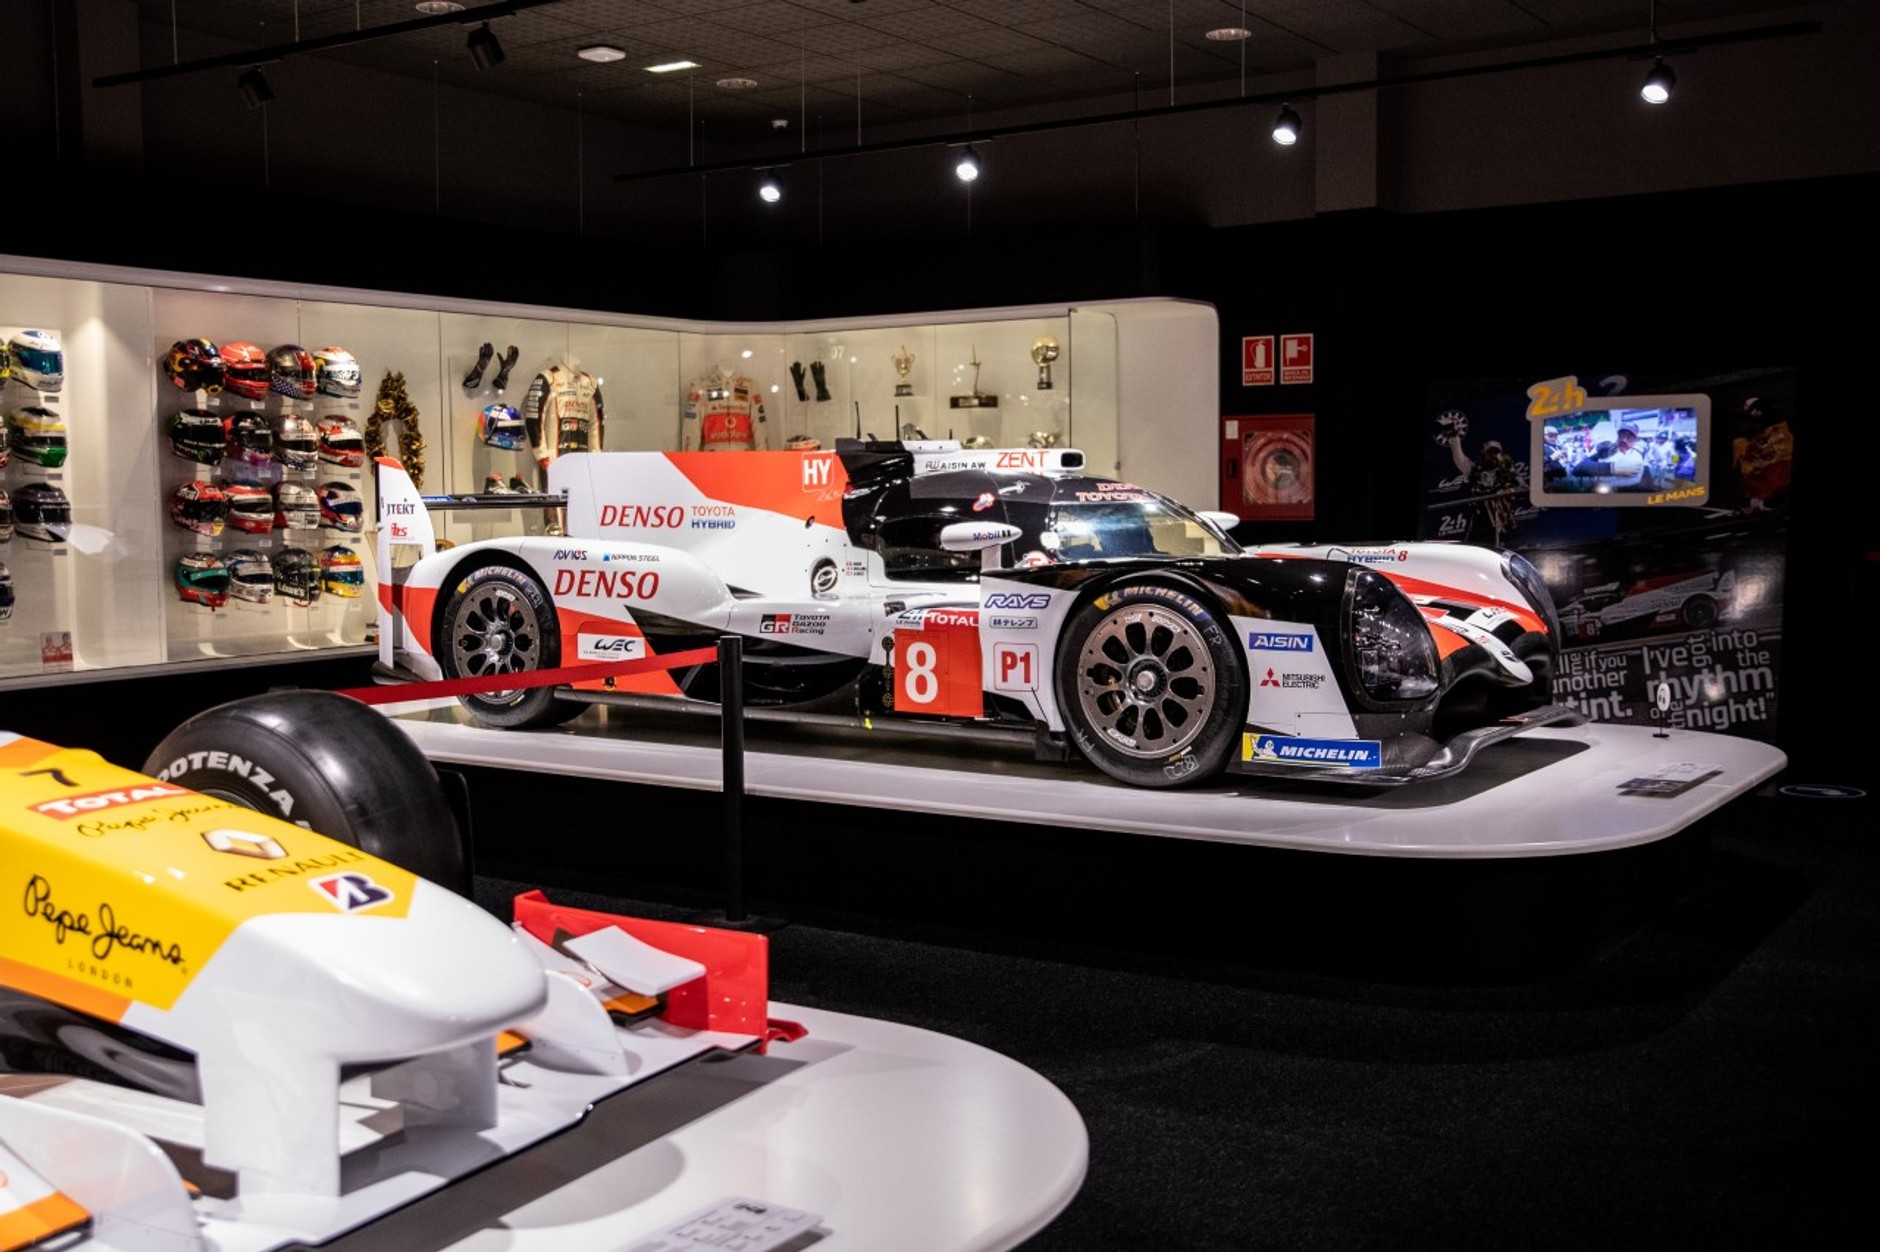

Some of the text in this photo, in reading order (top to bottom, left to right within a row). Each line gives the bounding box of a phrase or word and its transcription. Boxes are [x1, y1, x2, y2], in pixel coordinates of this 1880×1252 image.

[940, 461, 968, 470] AISIN
[996, 451, 1050, 468] ZENT
[803, 459, 831, 485] HY
[1647, 486, 1705, 505] LE MANS
[387, 504, 415, 516] JTEKT
[600, 505, 685, 529] DENSO
[691, 506, 736, 517] TOYOTA
[691, 519, 736, 530] HYBRID
[611, 554, 660, 562] NIPPON STEEL
[1397, 550, 1408, 562] 8
[473, 566, 527, 586] MICHELIN
[554, 569, 660, 600] DENSO
[985, 593, 1052, 609] RAYS
[1123, 586, 1205, 617] MICHELIN
[761, 621, 788, 633] GR
[928, 612, 979, 627] TOTAL
[791, 627, 824, 635] Racing
[594, 638, 636, 653] WEC
[1254, 635, 1308, 649] AISIN
[1711, 629, 1758, 652] into
[1599, 655, 1627, 672] you
[1736, 649, 1771, 667] the
[905, 642, 938, 703] 8
[1002, 651, 1031, 684] P1
[1282, 680, 1319, 689] ELECTRIC
[1280, 746, 1369, 761] MICHELIN
[38, 786, 188, 814] TOTAL
[224, 852, 365, 892] RENAULT
[24, 874, 186, 965] Pepe Jeans
[68, 958, 134, 989] LONDON
